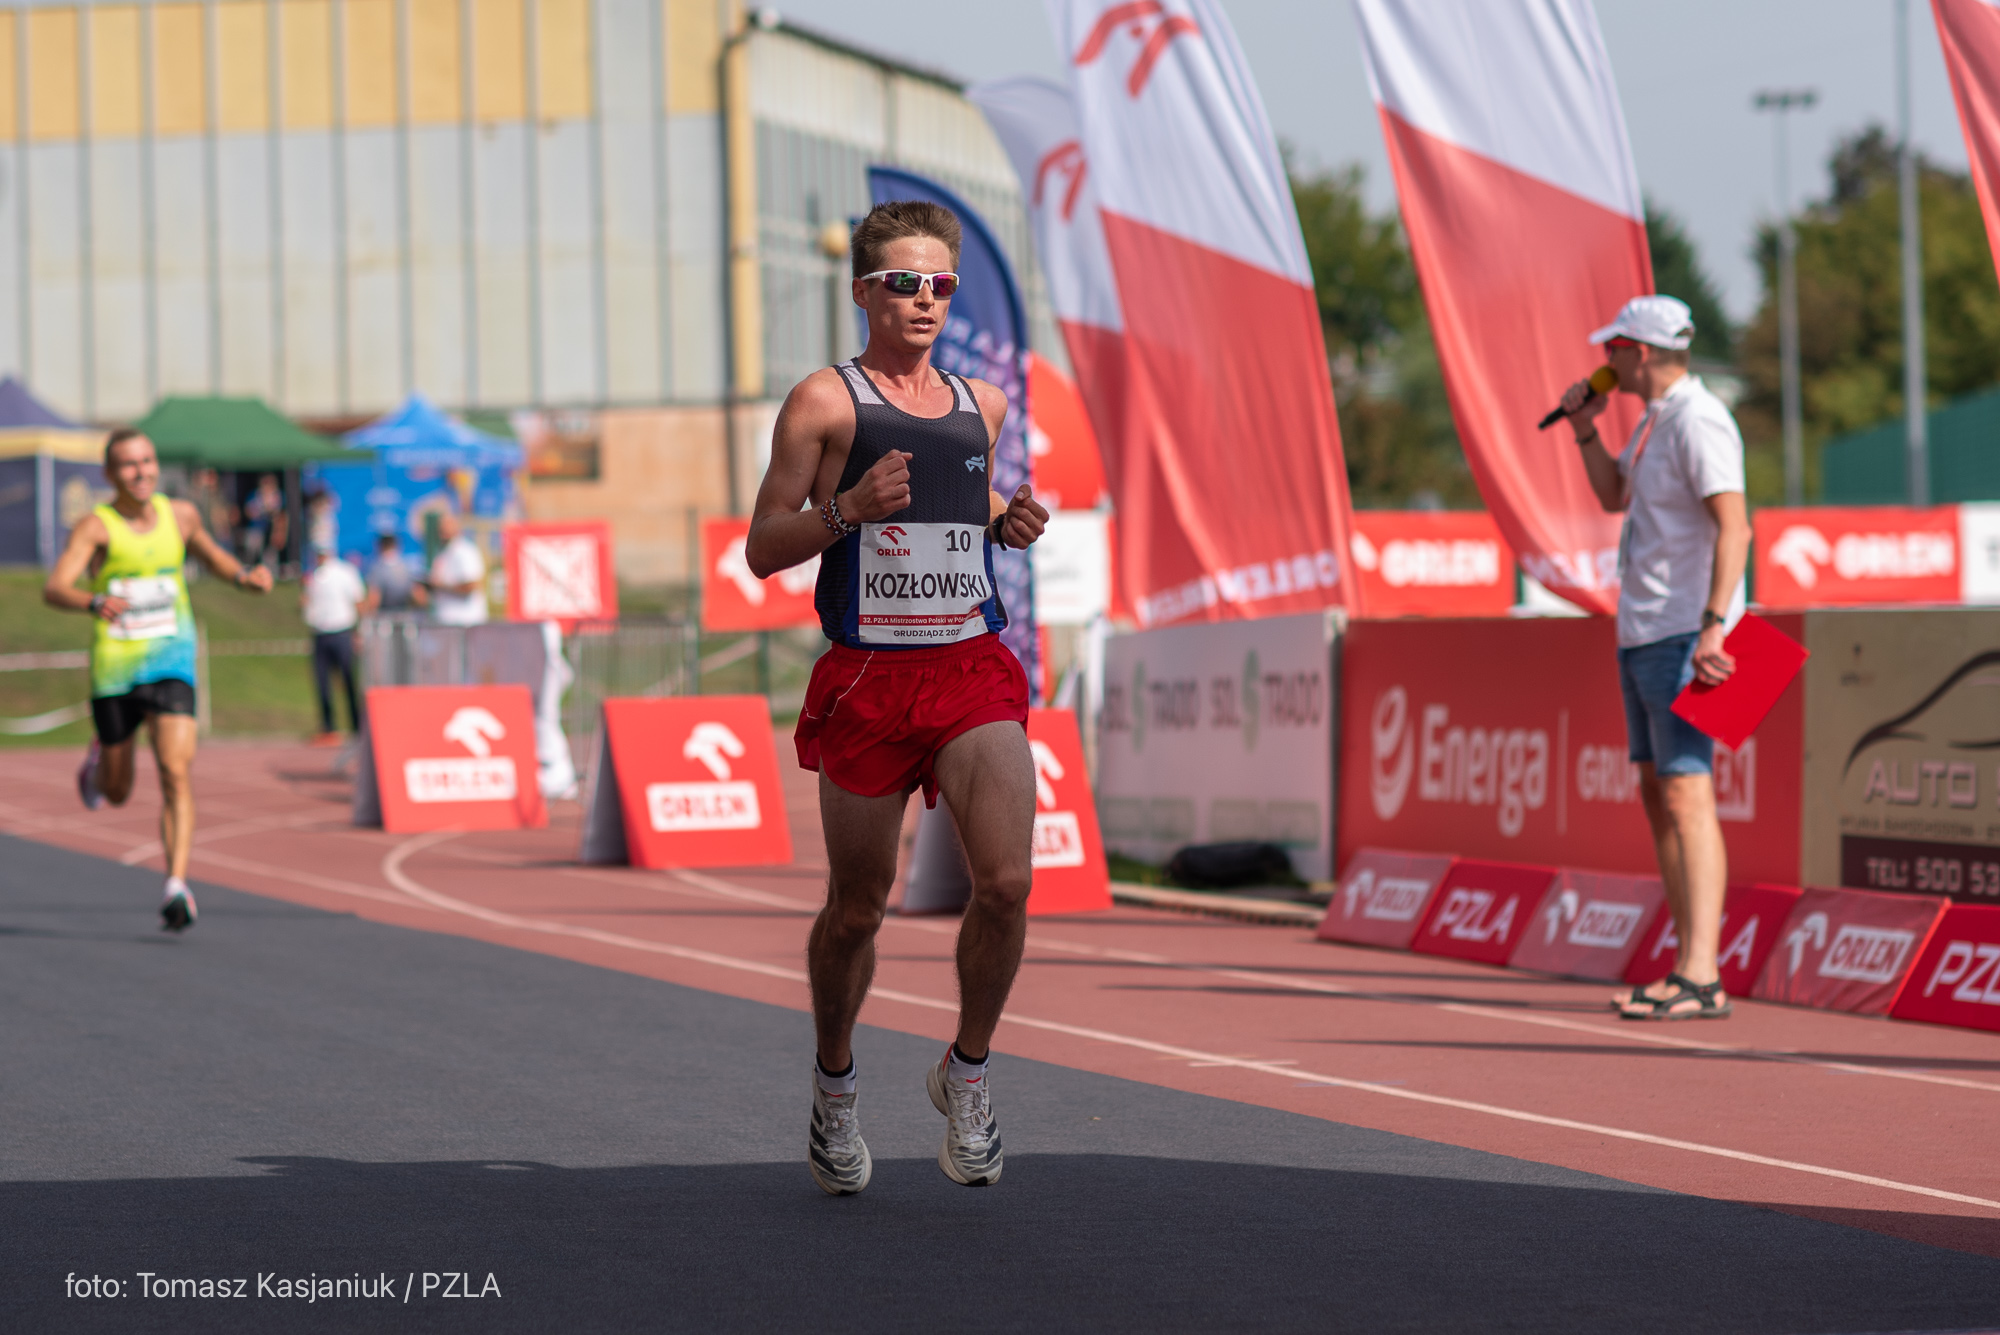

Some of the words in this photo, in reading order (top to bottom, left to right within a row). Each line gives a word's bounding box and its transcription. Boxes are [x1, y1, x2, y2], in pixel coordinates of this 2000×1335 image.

[877, 548, 911, 557] ORLEN
[945, 529, 971, 552] 10
[1833, 532, 1955, 579] ORLEN
[1379, 539, 1500, 587] ORLEN
[865, 572, 987, 599] KOZŁOWSKI
[893, 629, 944, 638] GRUDZIĄDZ
[945, 628, 962, 636] 202
[928, 616, 947, 624] Polski
[1420, 704, 1549, 837] Energa
[1864, 758, 1977, 809] AUTO
[1914, 857, 1962, 893] 500
[1429, 886, 1521, 946] PZLA
[1829, 933, 1905, 975] ORLEN
[1922, 939, 2000, 1006] PZL
